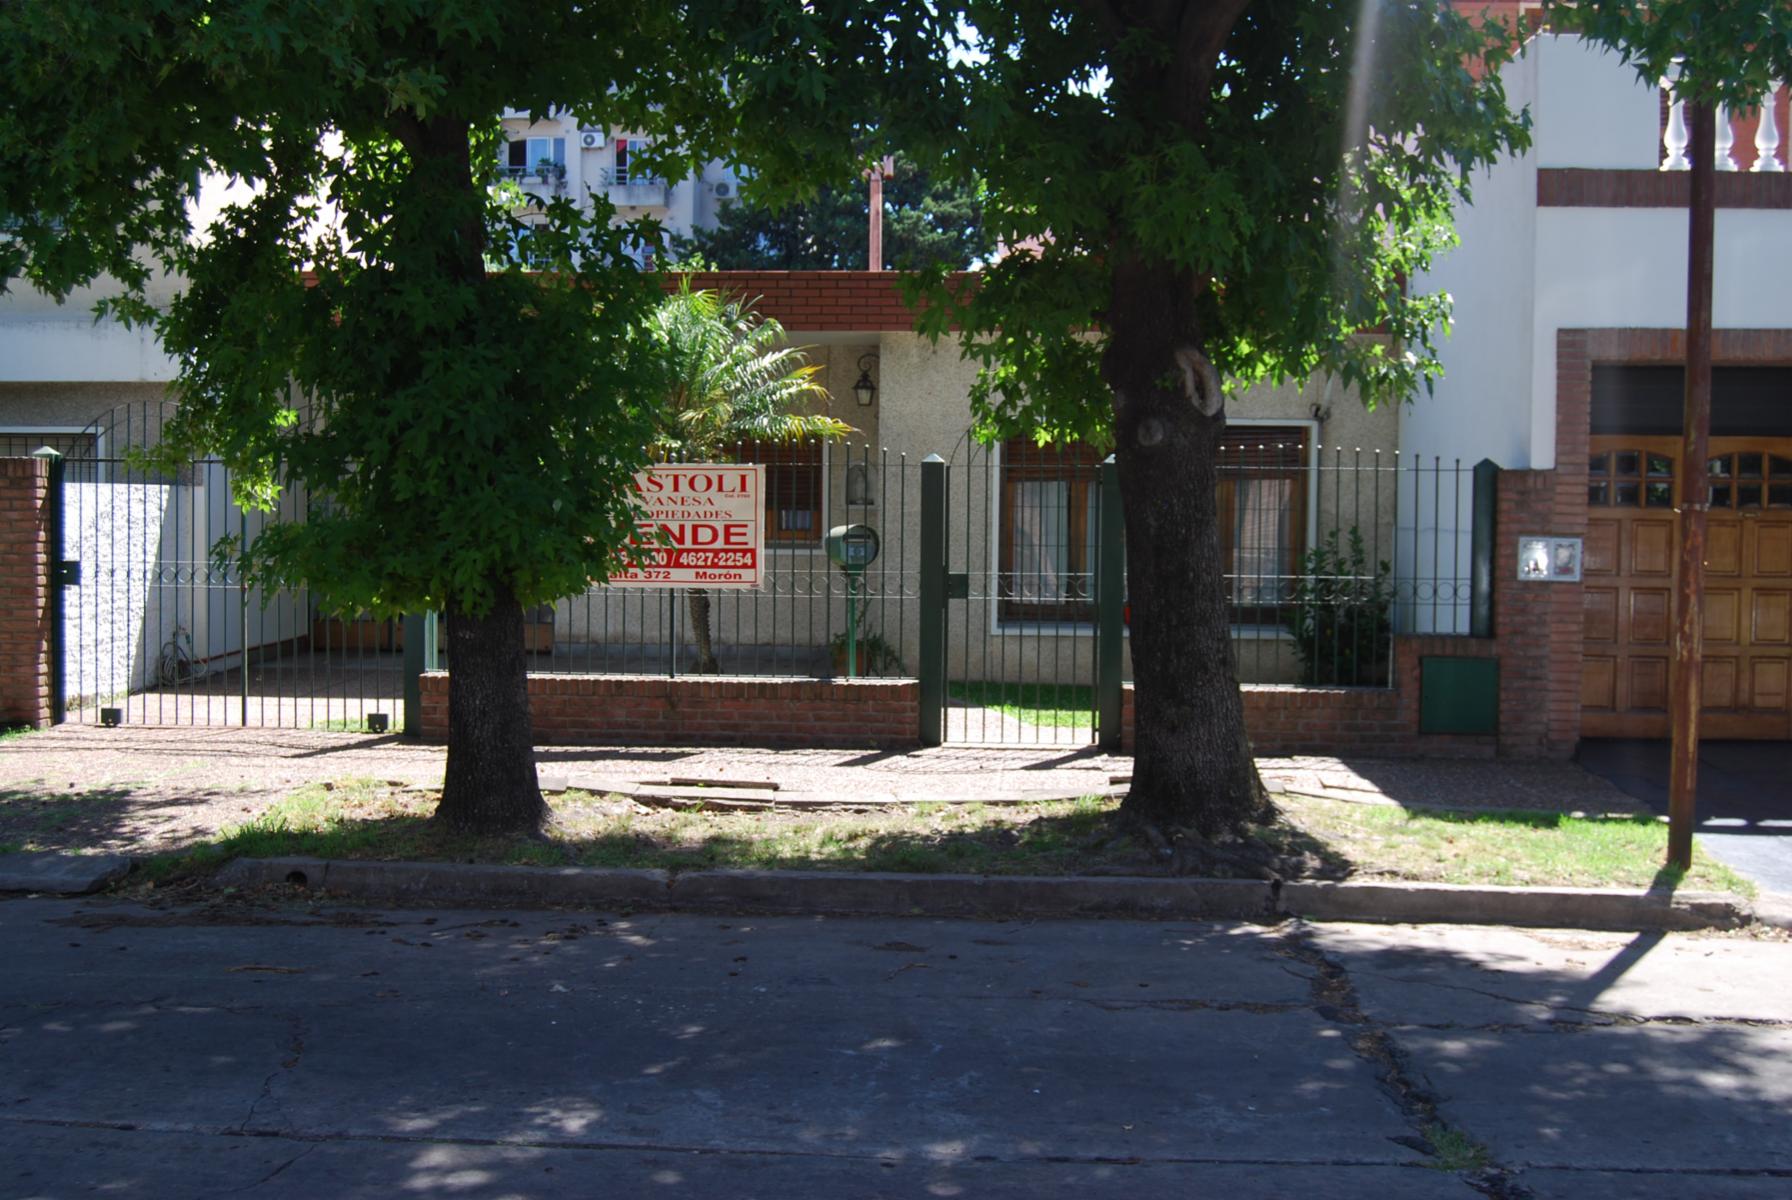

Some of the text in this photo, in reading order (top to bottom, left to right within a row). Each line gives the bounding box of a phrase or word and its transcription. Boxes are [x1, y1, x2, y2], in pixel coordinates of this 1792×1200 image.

[632, 473, 750, 493] ASTOLI
[643, 495, 715, 506] VANESA
[629, 523, 749, 546] ENDE
[679, 552, 753, 567] 4627-2254
[608, 569, 743, 580] alta 372 Morón
